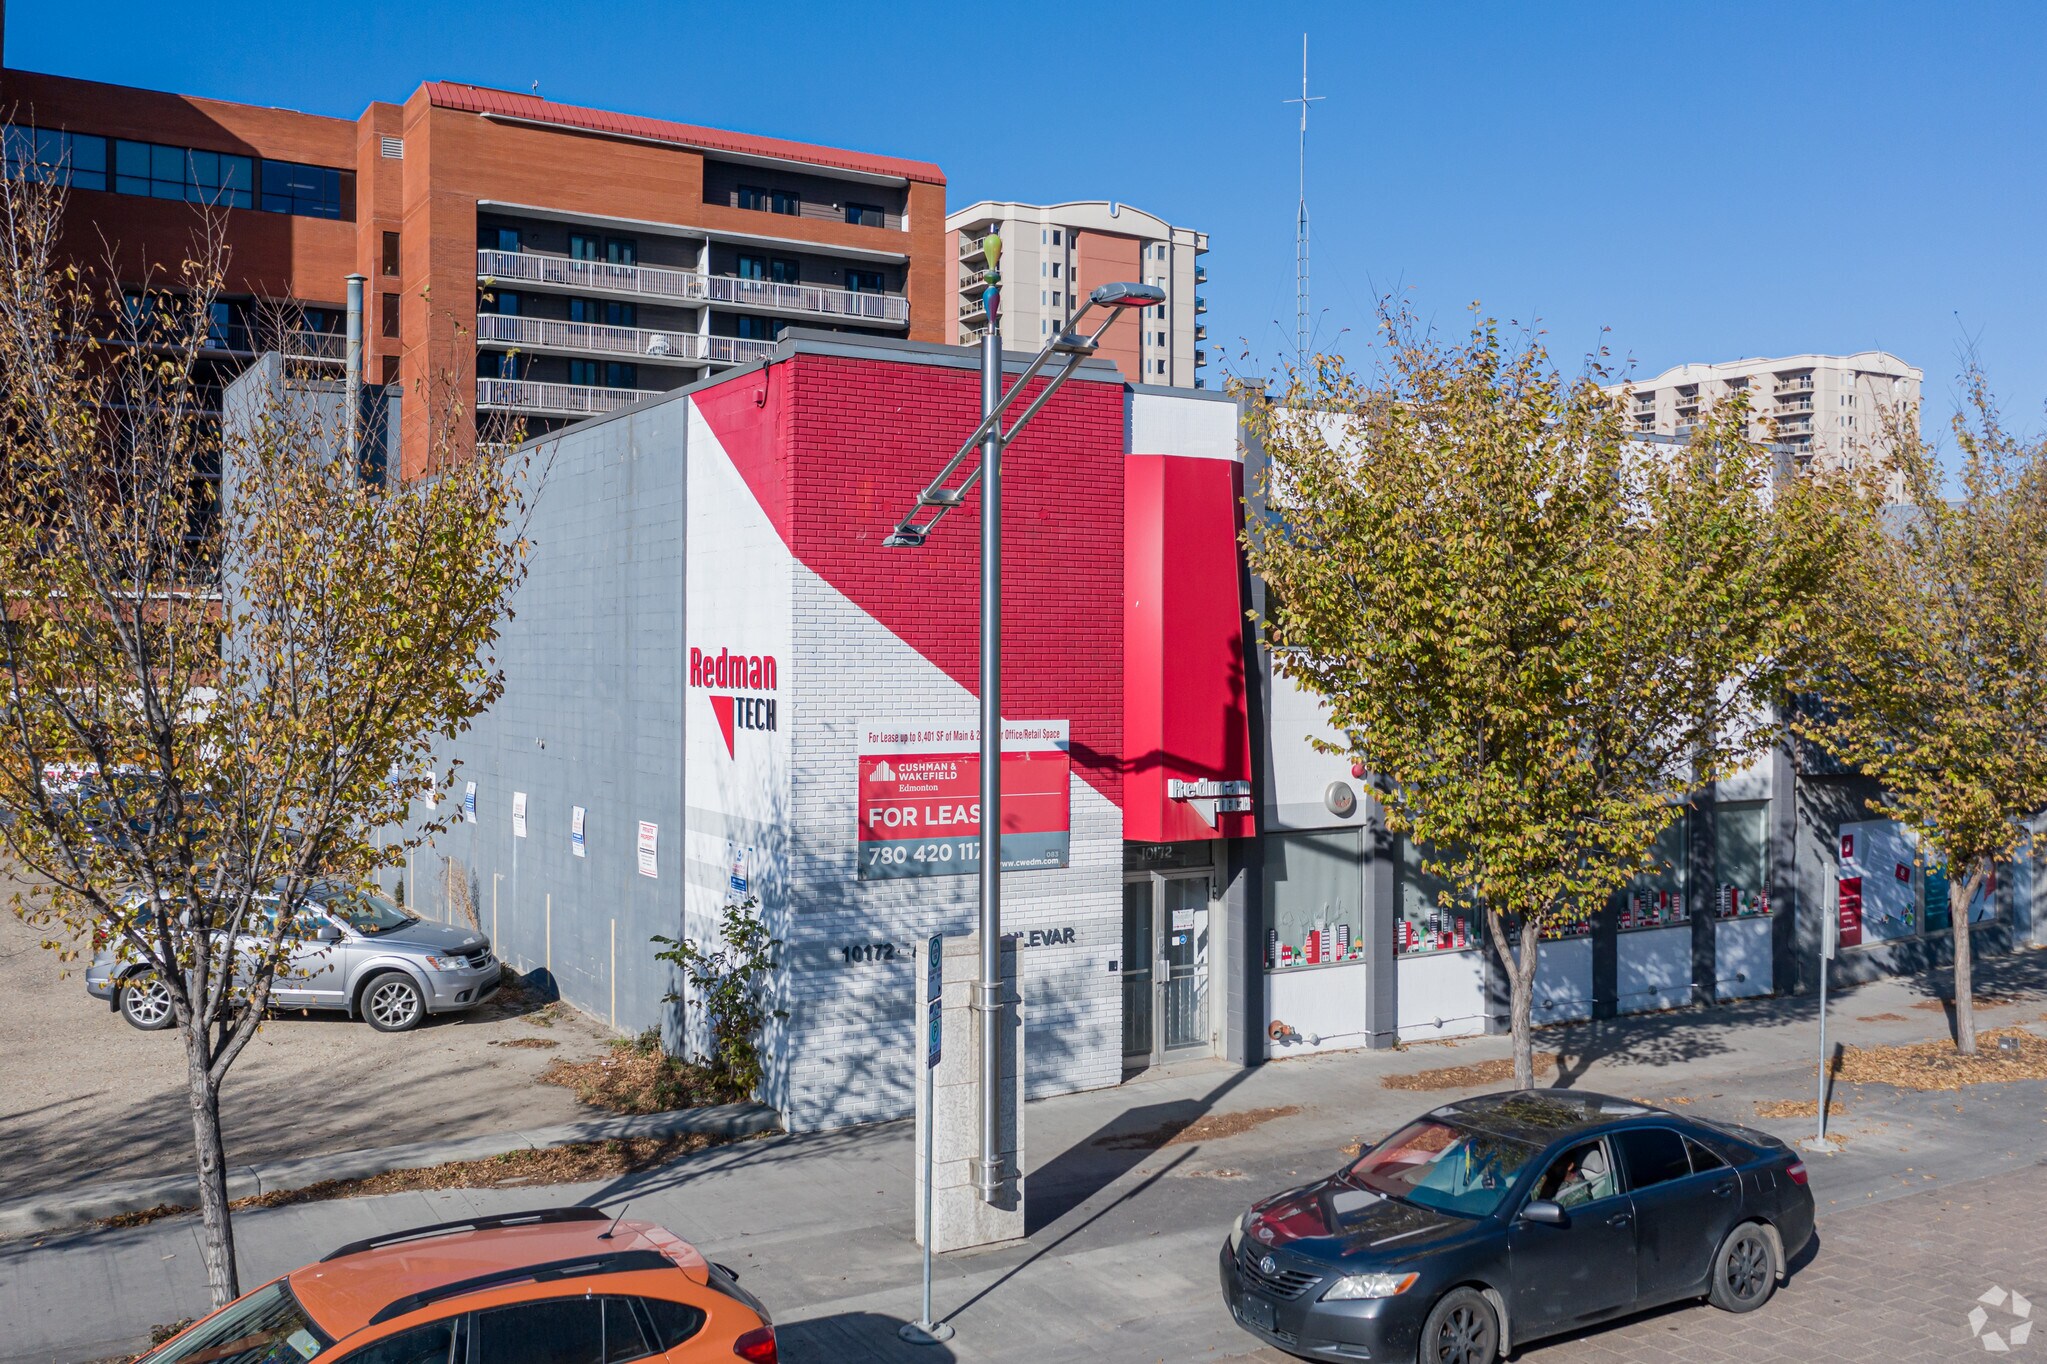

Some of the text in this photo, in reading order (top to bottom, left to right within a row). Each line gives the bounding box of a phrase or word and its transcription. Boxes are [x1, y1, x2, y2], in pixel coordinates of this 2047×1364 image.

[690, 647, 777, 691] Redman
[735, 697, 777, 732] TECH
[868, 732, 879, 743] For
[880, 731, 899, 742] Lease
[900, 733, 909, 744] up
[910, 732, 917, 742] to
[917, 731, 935, 743] 8,401
[936, 730, 944, 741] SF
[945, 730, 953, 741] of
[954, 730, 969, 740] Main
[970, 730, 975, 740] &
[1004, 729, 1042, 741] Office/Retail
[1042, 728, 1061, 741] Space
[898, 762, 957, 772] CUSHMAN &
[898, 771, 958, 781] WAKEFIELD
[898, 784, 939, 793] Edmonton
[1167, 777, 1251, 799] Redman
[868, 803, 981, 829] FOR LEAS
[869, 846, 908, 866] 780
[913, 843, 953, 863] 420
[1141, 846, 1172, 861] 10172
[841, 943, 897, 963] 10172
